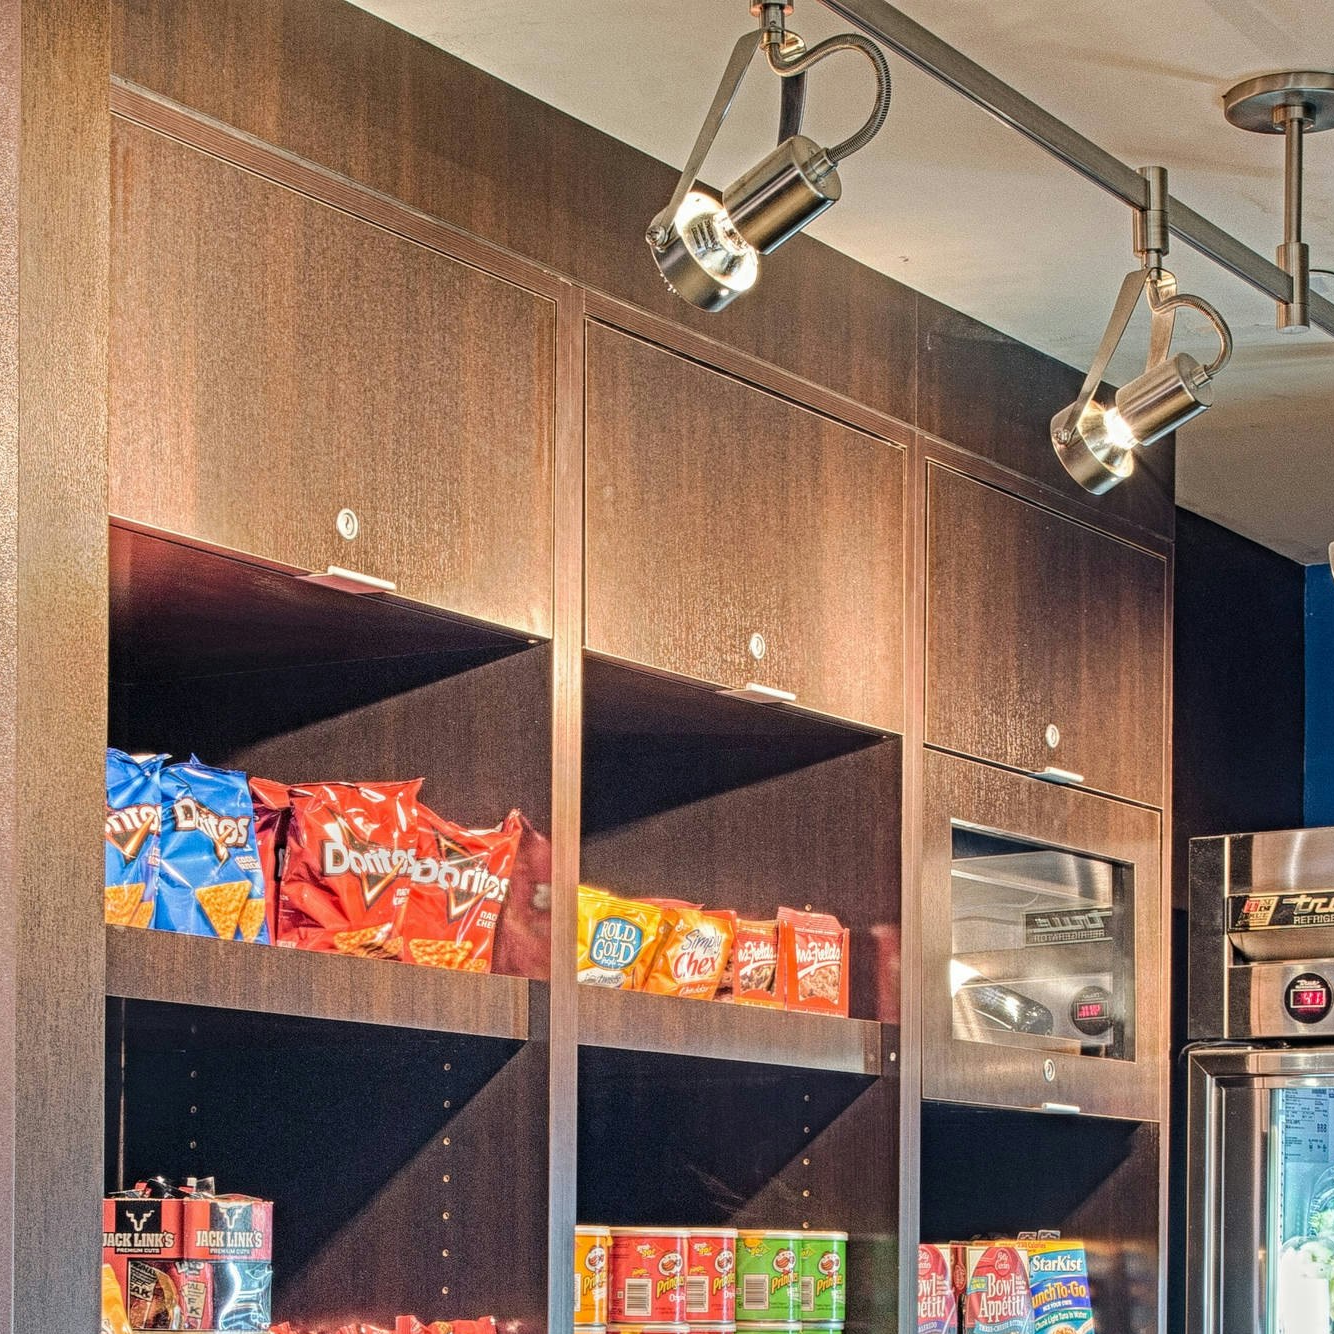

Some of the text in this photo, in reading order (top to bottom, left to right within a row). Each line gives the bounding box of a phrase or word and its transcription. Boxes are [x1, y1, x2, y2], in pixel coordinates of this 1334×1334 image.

[323, 840, 417, 876] Doritos
[411, 857, 511, 903] Doritos
[600, 920, 636, 941] ROLD
[592, 938, 636, 965] GOLD
[673, 951, 717, 979] Chex
[103, 1232, 174, 1248] JACK LINK'S
[196, 1230, 263, 1249] JACK LINK'S
[1032, 1254, 1084, 1272] StarKist
[987, 1272, 1016, 1298] Bowl
[1031, 1284, 1055, 1309] unch
